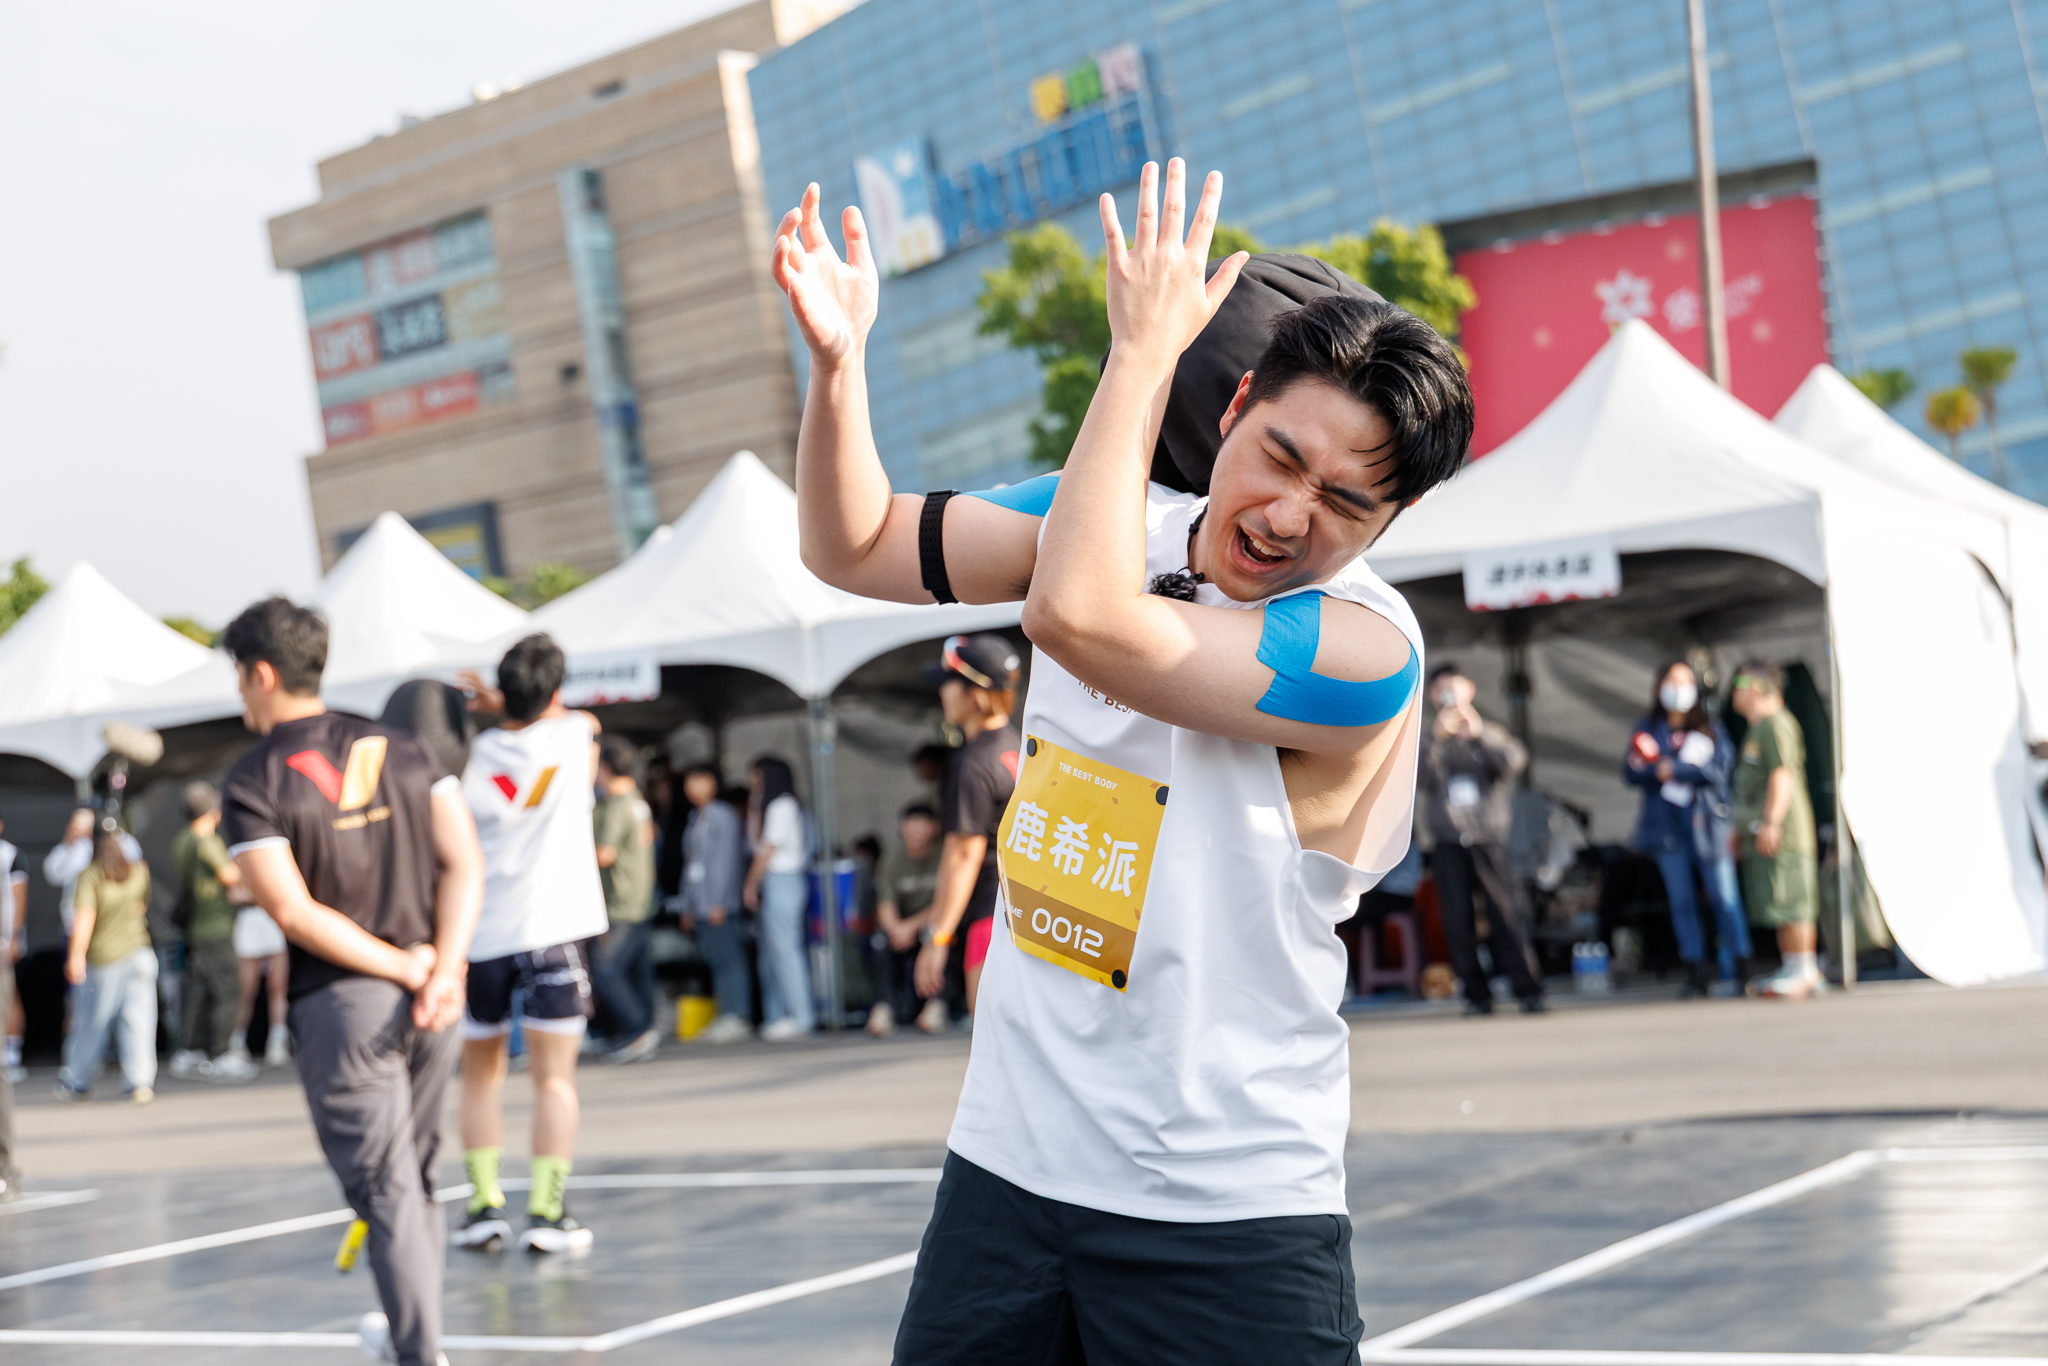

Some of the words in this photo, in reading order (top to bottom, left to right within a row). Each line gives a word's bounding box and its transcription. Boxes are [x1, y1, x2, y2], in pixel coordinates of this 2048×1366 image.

[1059, 761, 1072, 774] THE
[1072, 768, 1093, 782] BEST
[1094, 776, 1118, 790] BODY
[1006, 800, 1139, 897] 鹿希派
[1031, 907, 1104, 958] 0012
